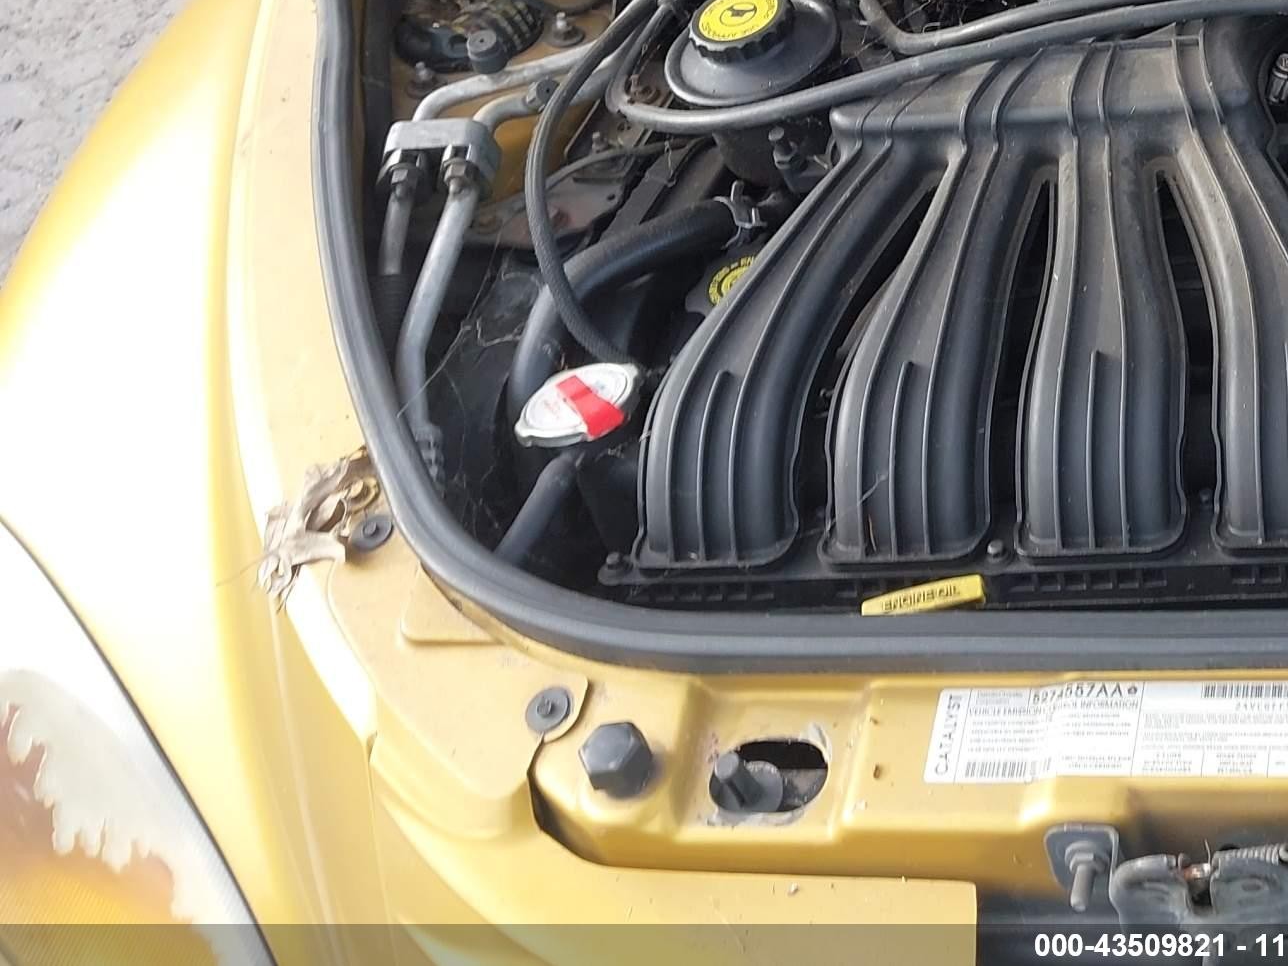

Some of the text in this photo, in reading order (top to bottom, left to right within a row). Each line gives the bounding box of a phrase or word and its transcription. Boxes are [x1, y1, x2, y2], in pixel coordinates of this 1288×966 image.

[882, 585, 961, 611] ENGINE OIL
[935, 694, 963, 776] CATALYST
